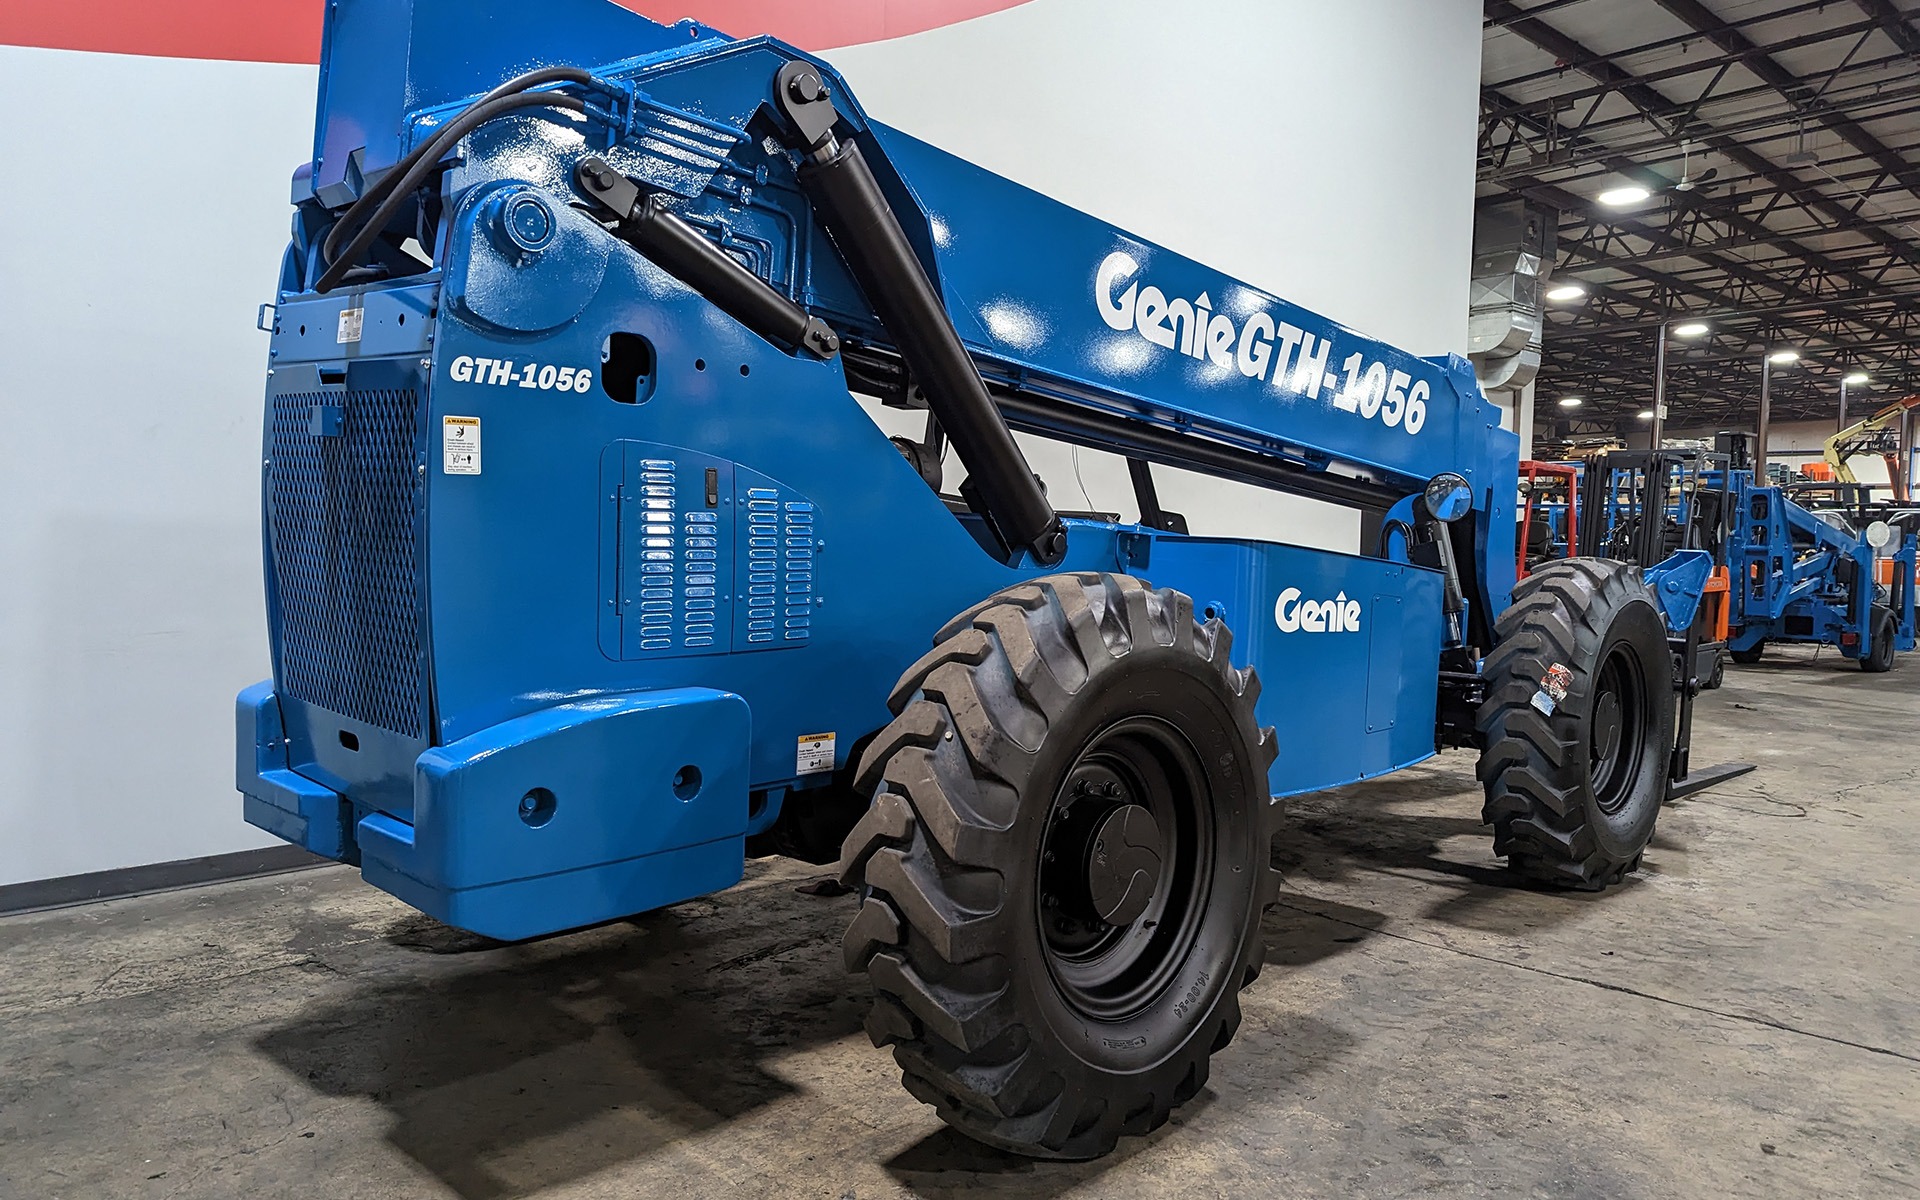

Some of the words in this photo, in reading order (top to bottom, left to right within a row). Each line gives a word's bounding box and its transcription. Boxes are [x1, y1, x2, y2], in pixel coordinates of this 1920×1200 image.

[450, 356, 592, 393] GTH-1056
[1275, 587, 1361, 633] Genie
[1174, 970, 1210, 1018] 14.00-24
